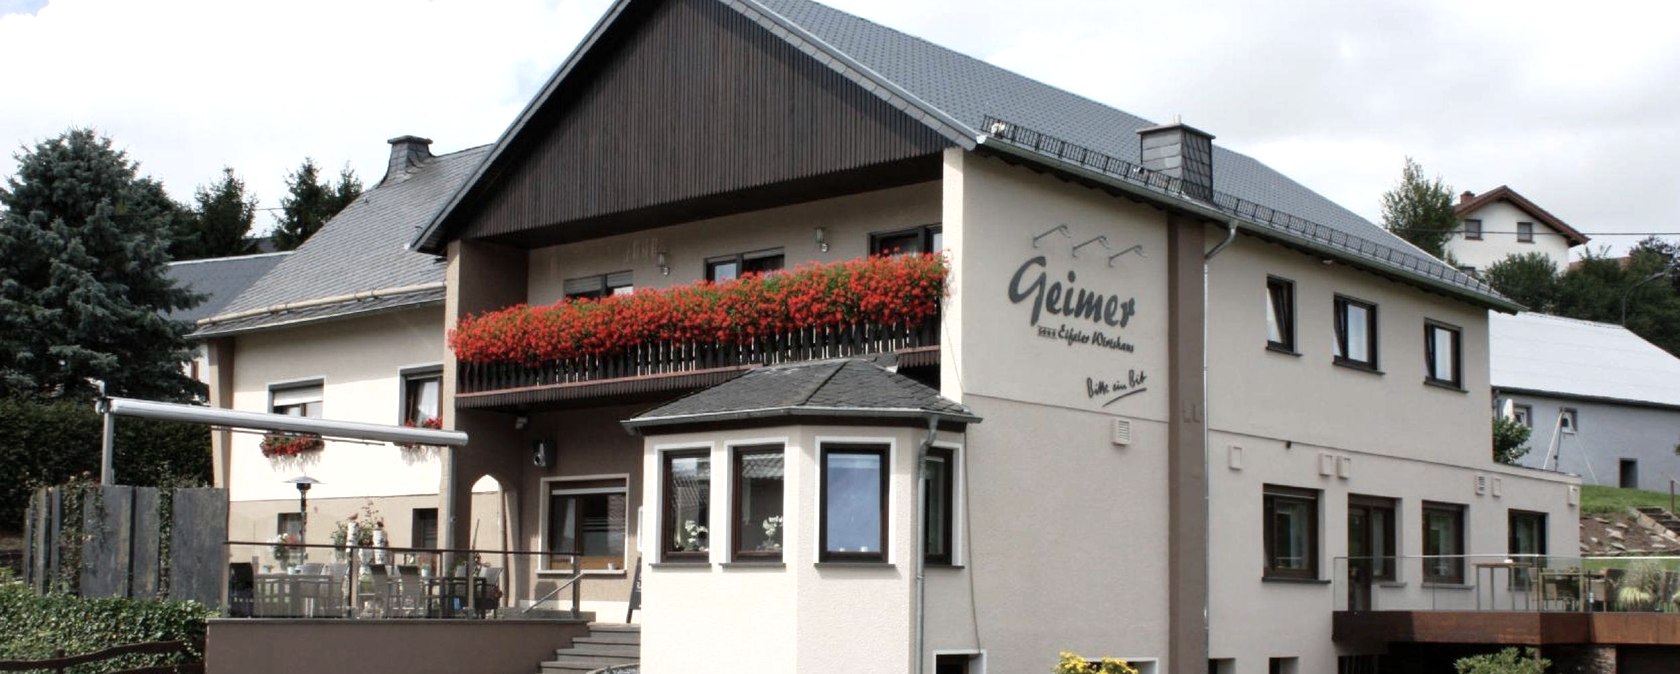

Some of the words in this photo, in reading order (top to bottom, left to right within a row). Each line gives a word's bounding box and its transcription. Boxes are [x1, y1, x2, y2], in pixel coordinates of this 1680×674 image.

[1008, 256, 1135, 328] Geimer
[1087, 377, 1110, 398] Bitte
[1112, 380, 1127, 391] ein
[1129, 369, 1147, 388] Bit
